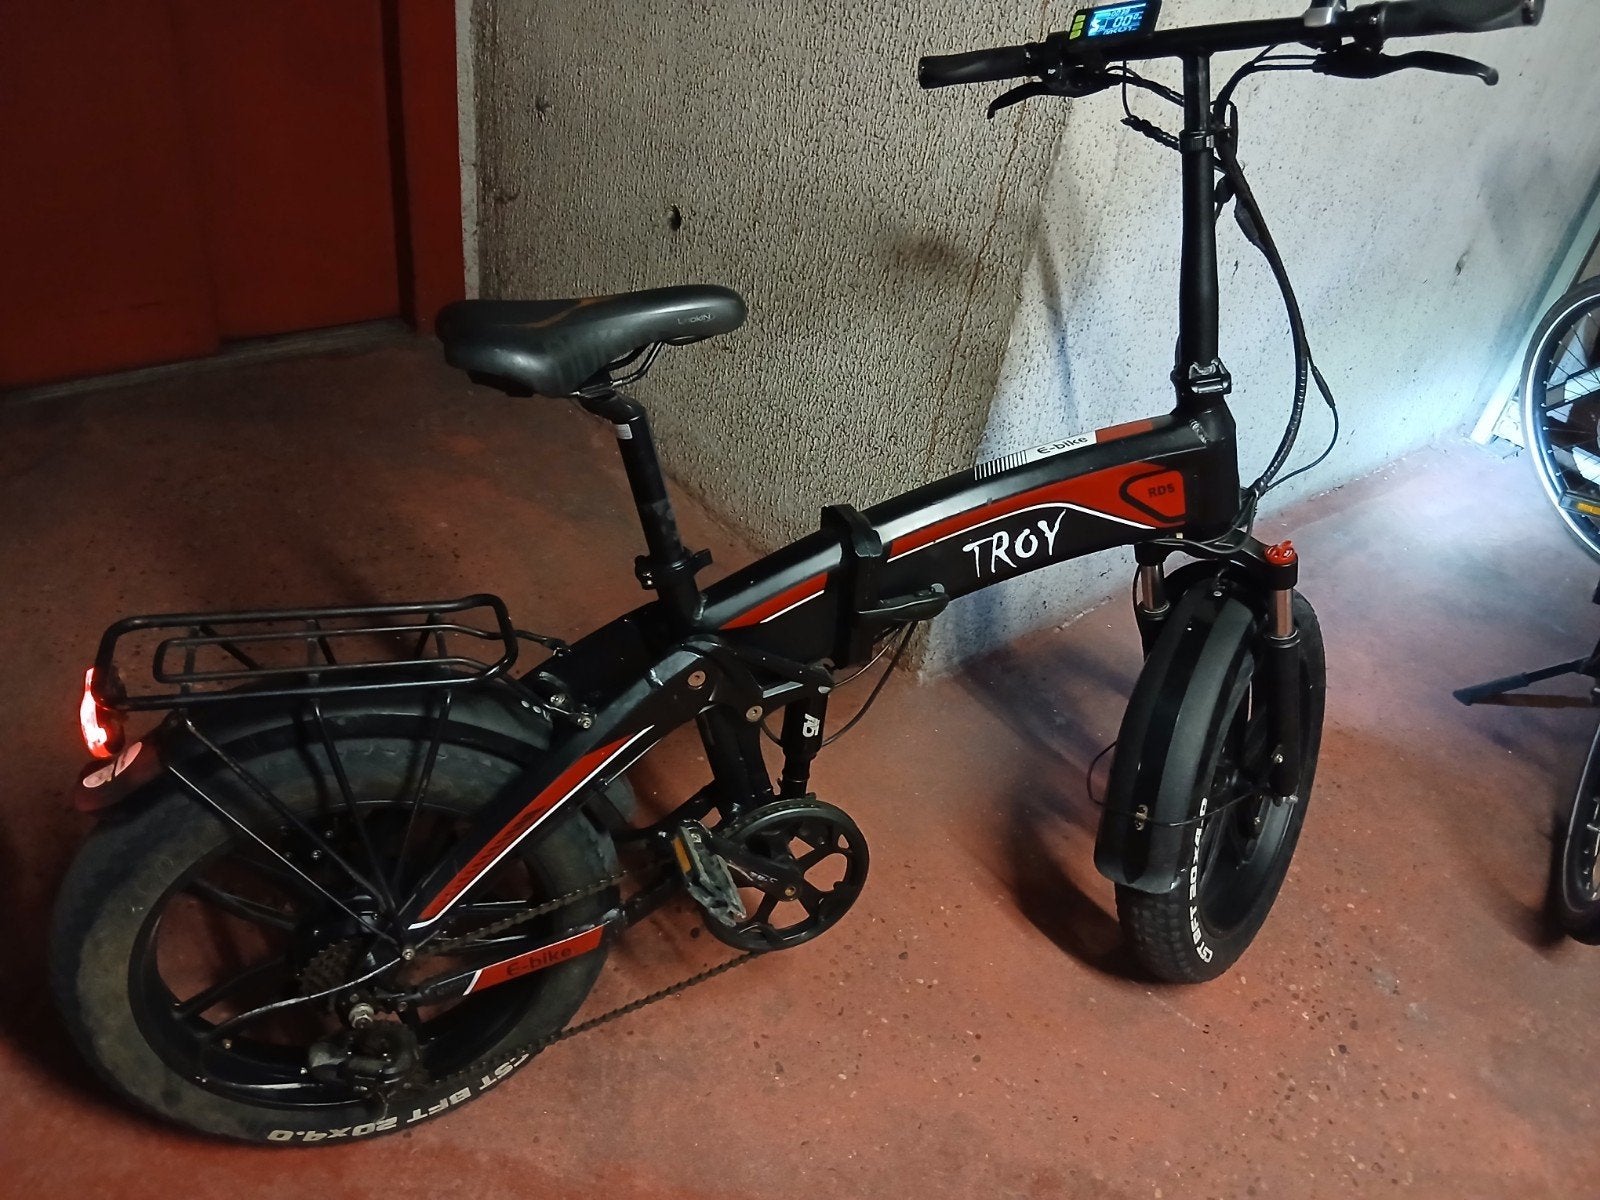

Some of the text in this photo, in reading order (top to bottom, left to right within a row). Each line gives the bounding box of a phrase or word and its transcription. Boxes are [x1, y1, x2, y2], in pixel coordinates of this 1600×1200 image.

[1037, 436, 1088, 455] E-bike
[962, 509, 1067, 578] TROY
[505, 946, 572, 976] E-bike
[407, 1087, 472, 1123] BFT
[267, 1116, 398, 1142] 20x4.0
